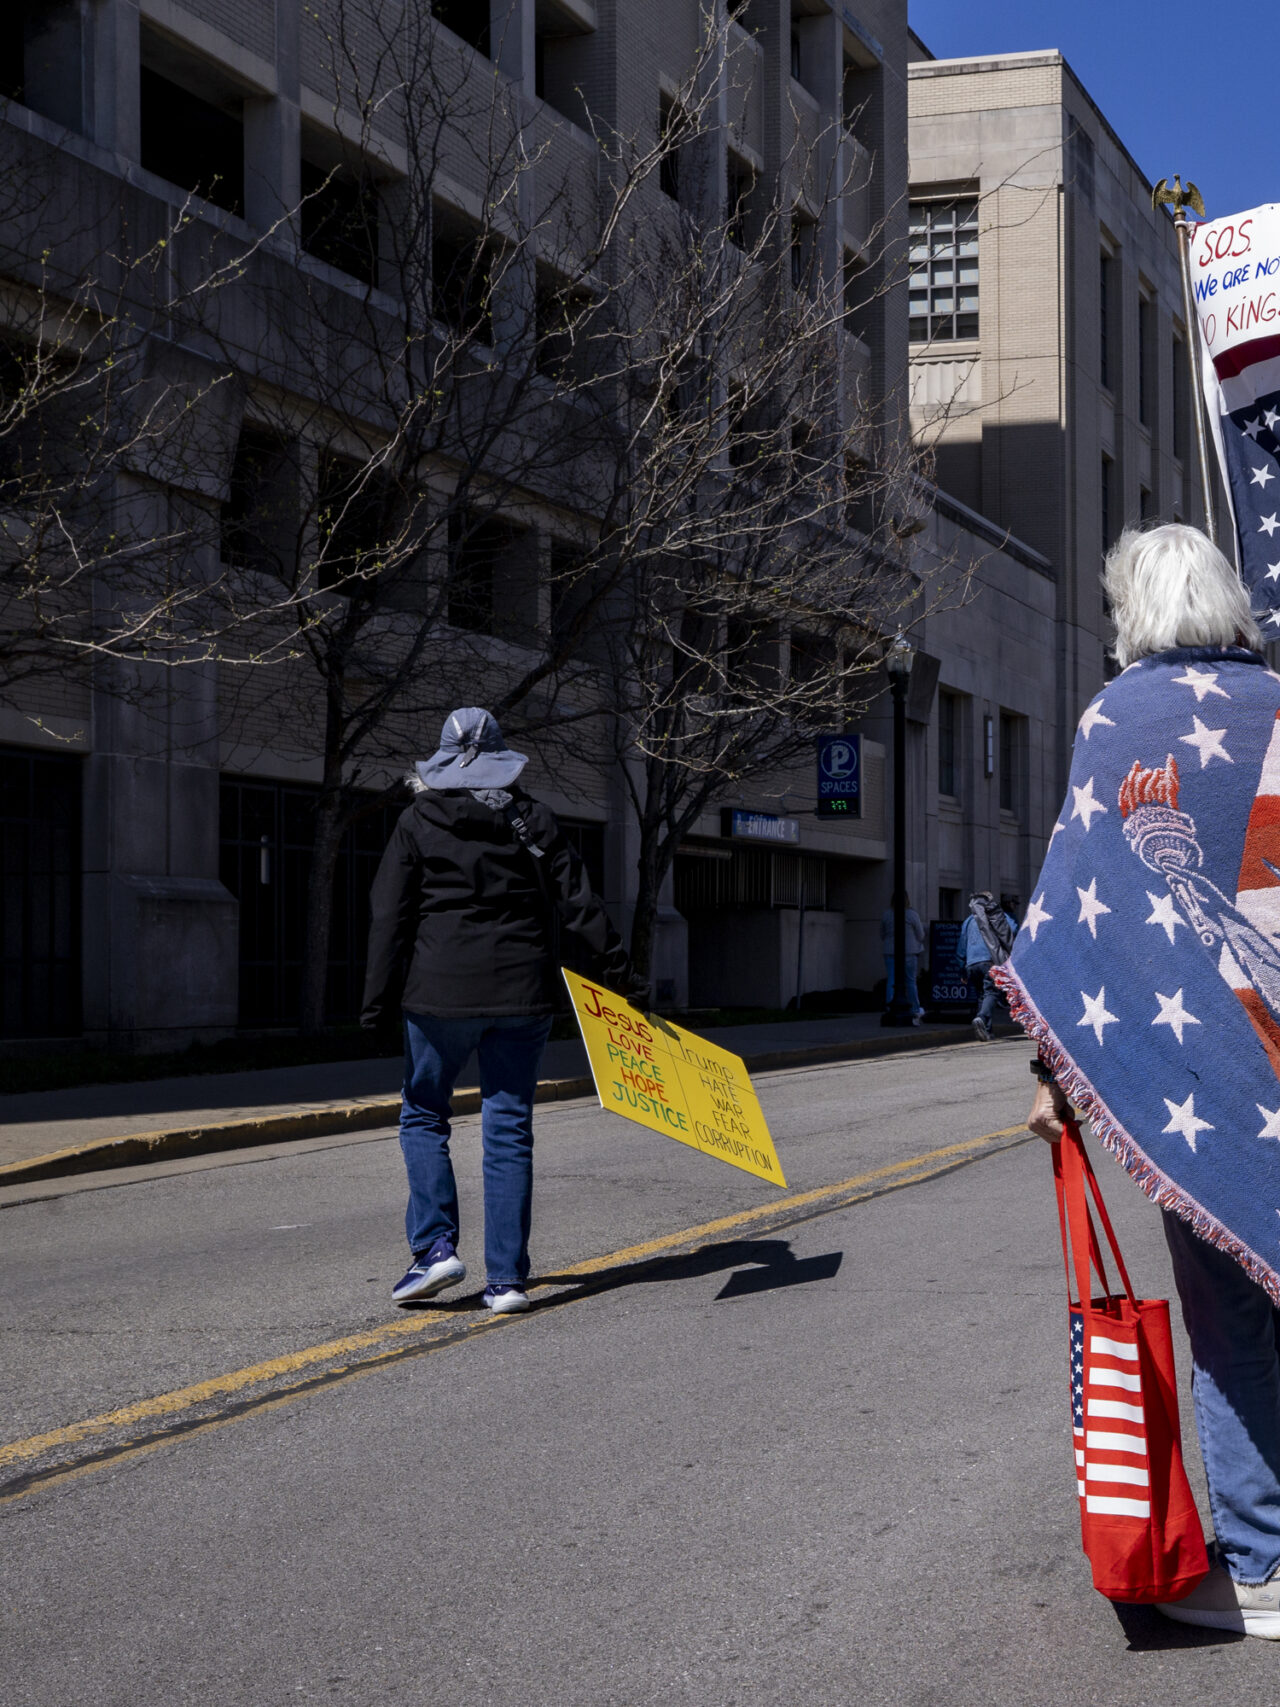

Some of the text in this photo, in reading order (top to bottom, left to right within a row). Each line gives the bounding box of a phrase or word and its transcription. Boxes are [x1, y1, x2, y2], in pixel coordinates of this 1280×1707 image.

[821, 780, 858, 793] SPACES
[748, 815, 785, 838] ENTRANCE
[932, 985, 968, 1000] $3.00
[581, 983, 653, 1043] Jesus
[608, 1028, 655, 1063] LOVE
[606, 1042, 665, 1084] PEACE
[620, 1066, 669, 1103] HOPE
[699, 1072, 738, 1104] HATE
[612, 1080, 689, 1132] JUSTICE
[710, 1093, 745, 1121] WAR
[712, 1110, 753, 1141] FEAR
[695, 1120, 773, 1172] CORRUPTION
